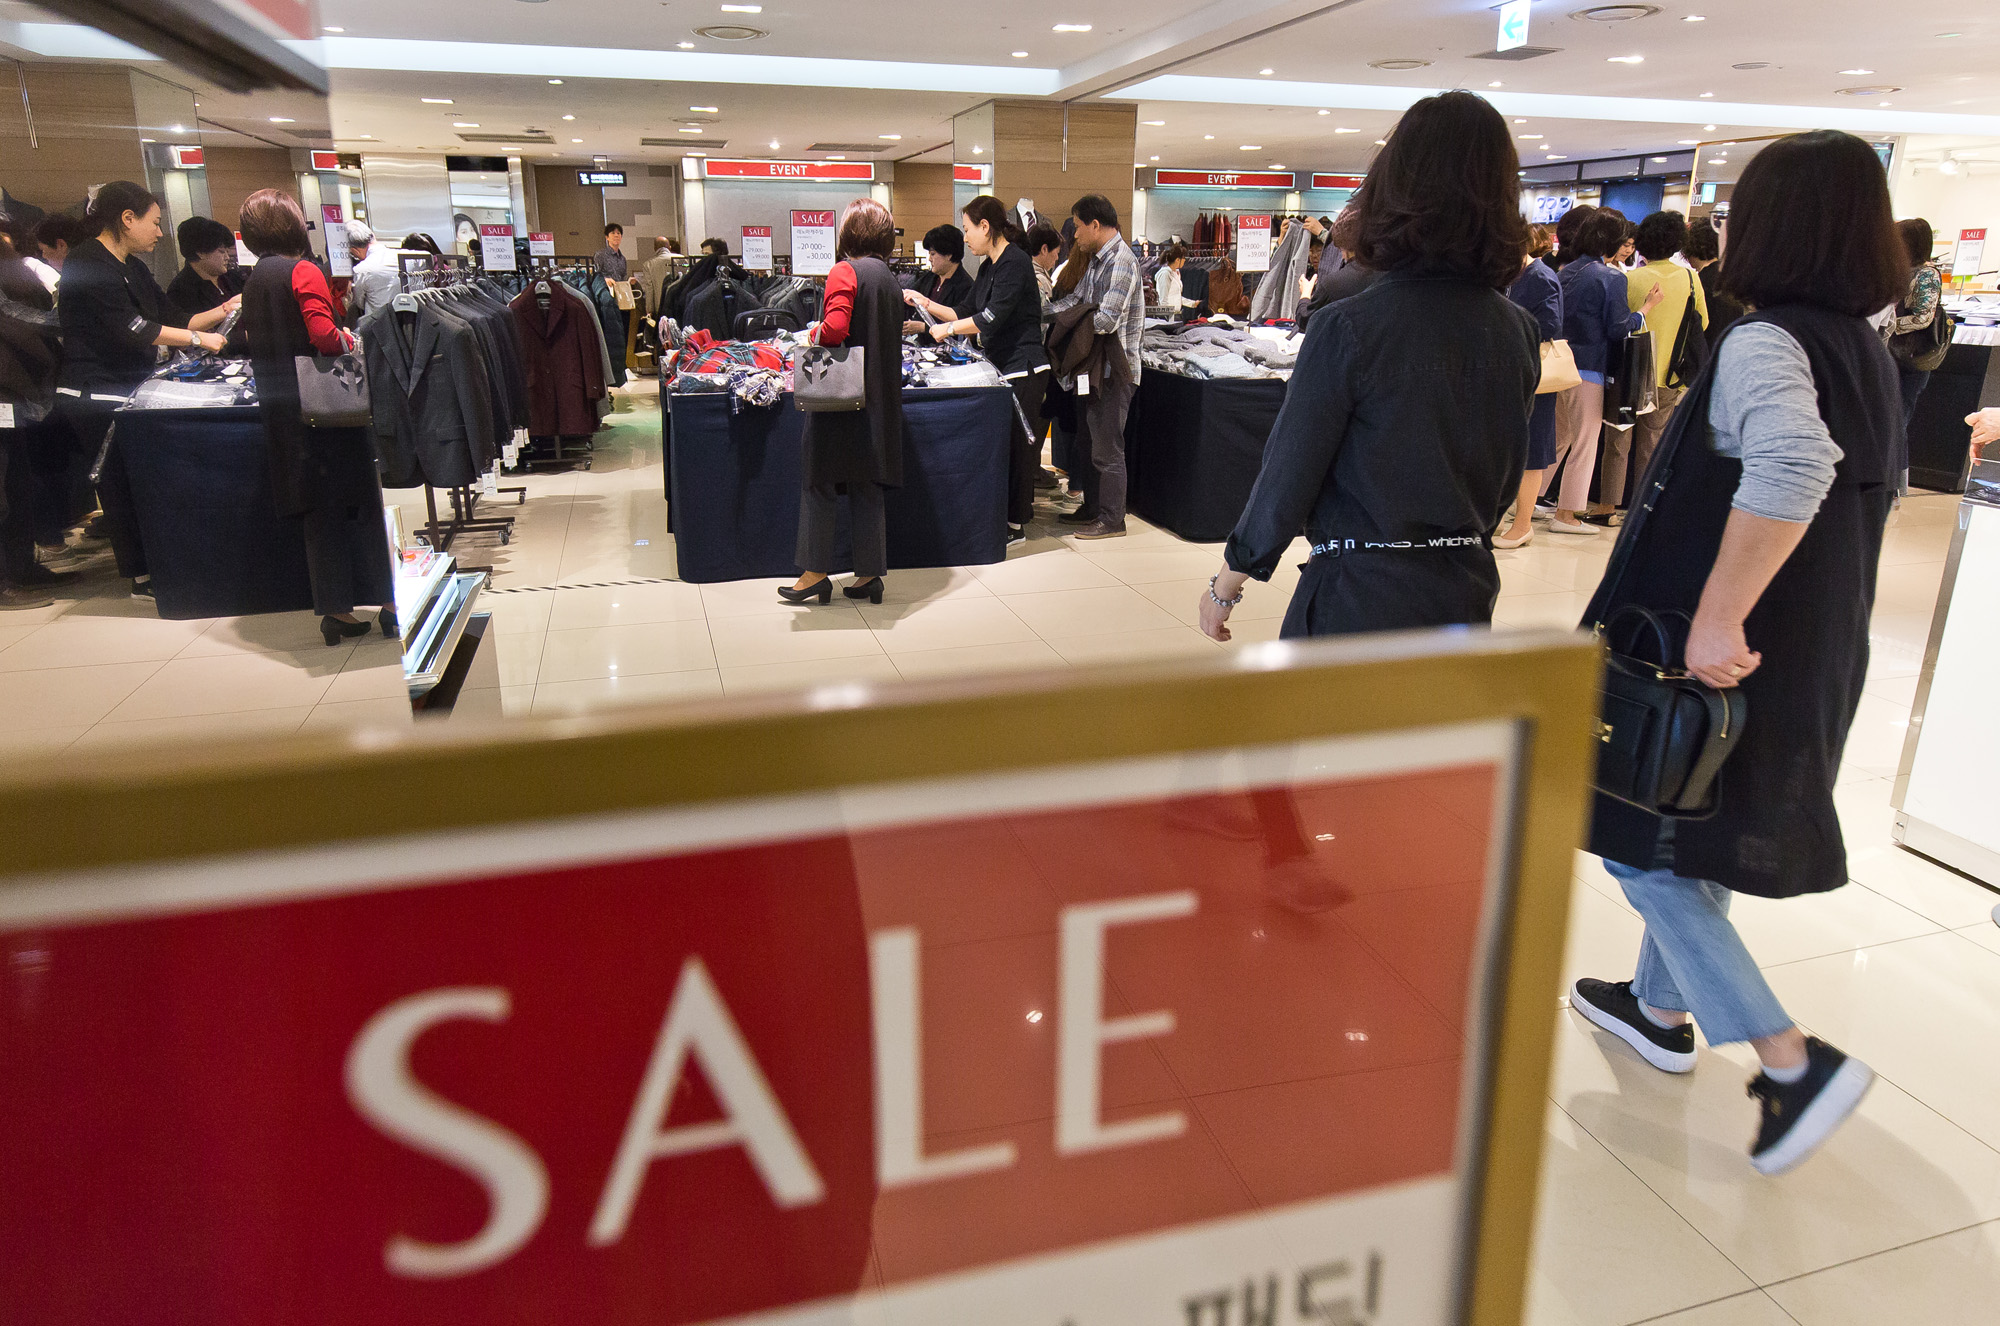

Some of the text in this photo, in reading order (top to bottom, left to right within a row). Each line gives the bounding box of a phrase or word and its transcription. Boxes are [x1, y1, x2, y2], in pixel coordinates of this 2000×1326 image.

[769, 164, 808, 176] EVENT
[1207, 174, 1238, 184] EVENT
[801, 213, 825, 224] SALE
[1245, 217, 1264, 227] SALE
[487, 227, 505, 235] SALE
[748, 228, 765, 236] SALE
[343, 891, 1198, 1279] SALE
